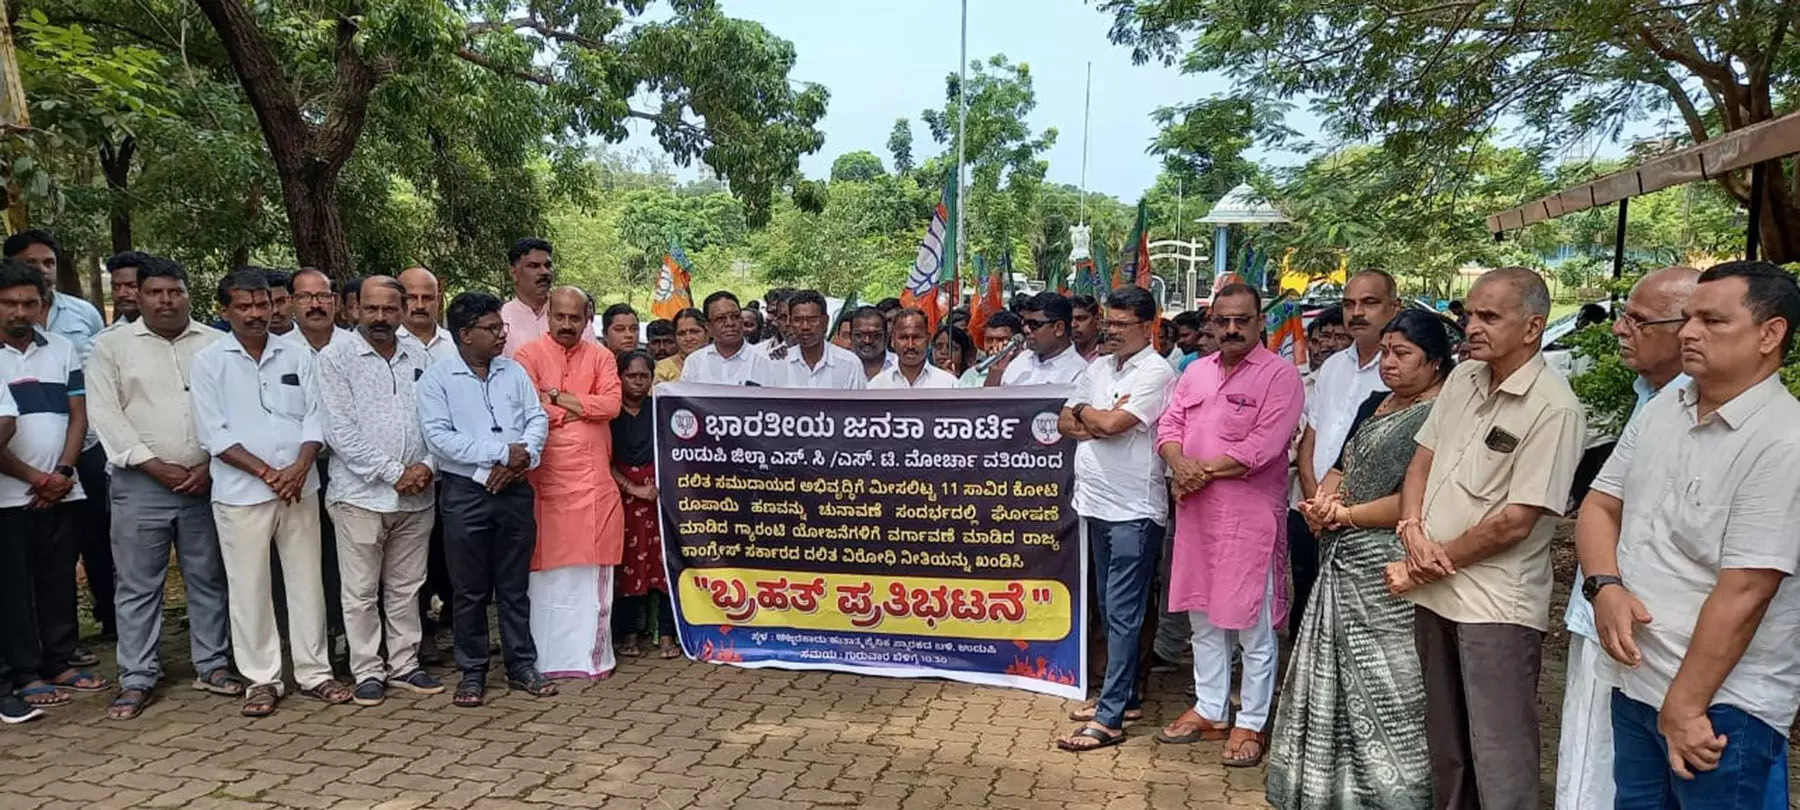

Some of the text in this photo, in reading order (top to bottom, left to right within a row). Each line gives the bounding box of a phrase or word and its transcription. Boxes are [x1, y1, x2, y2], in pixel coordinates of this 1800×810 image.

[705, 411, 1021, 441] ಭಾರತೀಯ ಜನತಾ ಪಾರ್ಟಿ
[671, 446, 727, 463] ಉಡುಪಿ
[731, 447, 769, 470] ಜಿಲ್ಲಾ
[904, 449, 978, 468] ಮೋರ್ಚಾ
[983, 451, 1063, 469] ವತಿಯಿಂದ
[677, 473, 711, 489] ದಲಿತ
[715, 475, 796, 492] ಸಮುದಾಯದ
[868, 479, 938, 501] ಮೀಸಲಿಟ್ಟ
[941, 482, 958, 496] 11
[963, 480, 1008, 497] ಸಾವಿರ
[1012, 481, 1058, 498] ಕೋಟಿ
[678, 497, 1060, 526] ರೂಪಾಯಿ ಹಣವನ್ನು ಚುನಾವಣೆ ಸಂದರ್ಭದಲ್ಲಿ ಘೋಷಣೆ
[679, 518, 1061, 551] ಮಾಡಿದ ಗ್ಯಾರಂಟಿ ಯೋಜನೆಗಳಿಗೆ ವರ್ಗಾವಣೆ ಮಾಡಿದ ರಾಜ್ಯ
[744, 544, 801, 561] ಸರ್ಕಾರದ
[804, 546, 838, 562] ದಲಿತ
[842, 546, 897, 566] ವಿರೋಧಿ
[900, 548, 971, 573] ನೀತಿಯನ್ನು
[975, 551, 1025, 569] ಖಂಡಿಸಿ
